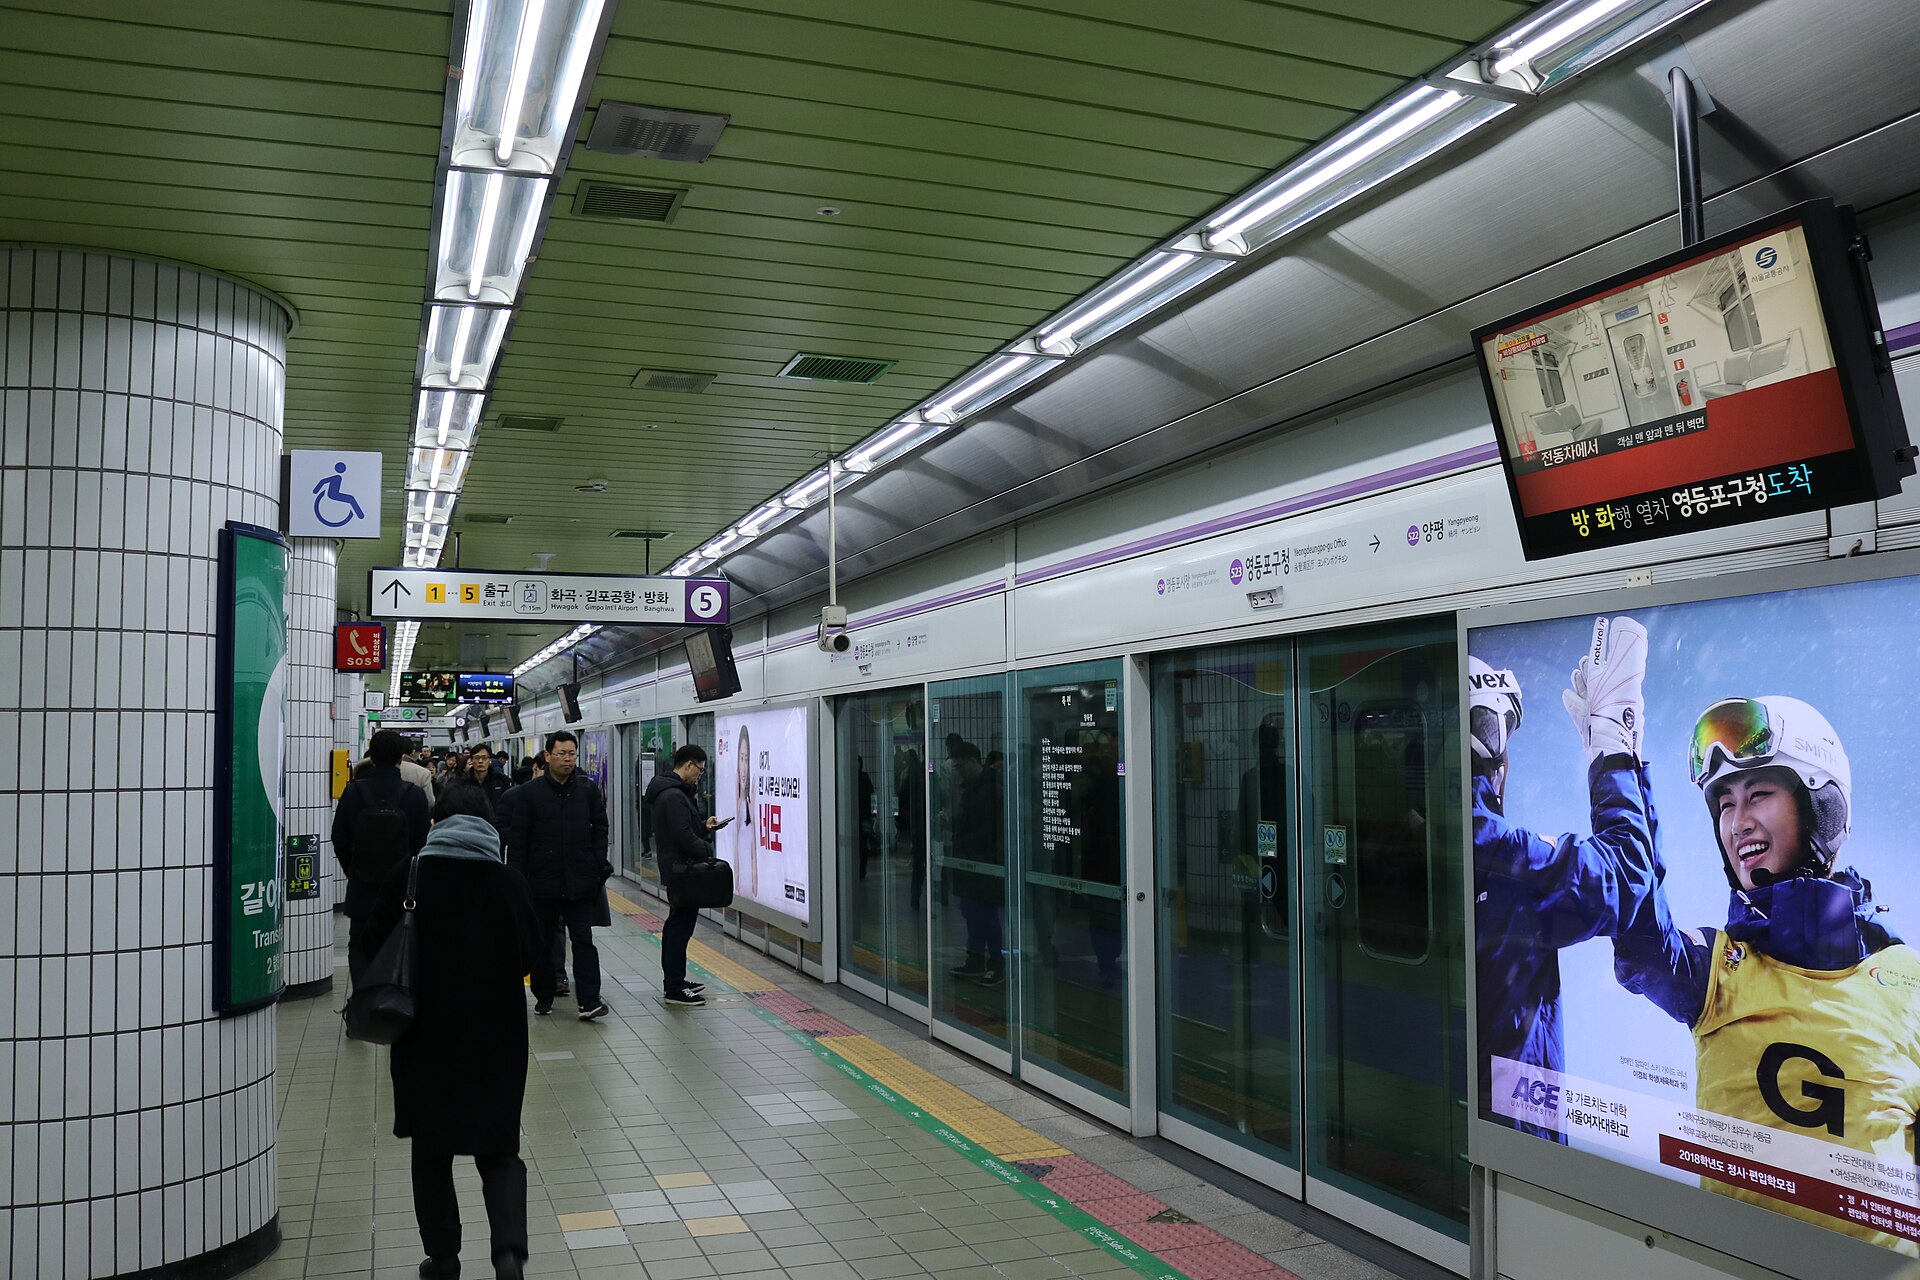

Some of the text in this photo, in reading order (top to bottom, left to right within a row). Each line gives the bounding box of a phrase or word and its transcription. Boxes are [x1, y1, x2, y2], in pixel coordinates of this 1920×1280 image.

[1635, 433, 1645, 443] 맨
[1645, 429, 1662, 442] 앞과
[1664, 426, 1674, 436] 맨
[1675, 422, 1685, 434] 뒤
[1687, 416, 1705, 429] 벽면
[1541, 438, 1599, 467] 전동차에서
[1447, 514, 1479, 527] Yangpyeong
[1637, 498, 1670, 526] 열차
[1407, 530, 1419, 541] 522
[1422, 518, 1444, 542] 양평
[1230, 566, 1242, 579] 523
[1245, 547, 1290, 582] 영등포구청
[431, 587, 474, 600] 1 5
[483, 583, 510, 598] 출구
[551, 588, 669, 605] 화곡 김포공항 방화
[483, 599, 496, 607] Exit
[551, 603, 579, 611] Hwagok
[585, 604, 604, 612] Gimpo
[617, 604, 638, 612] Airport
[644, 605, 675, 613] Banghwa
[700, 592, 712, 612] 5
[346, 657, 372, 666] SOS
[1469, 673, 1510, 690] vex
[1794, 737, 1837, 767] SMITH
[759, 803, 783, 853] 네모
[1511, 1076, 1560, 1111] ACE
[1757, 1042, 1845, 1138] G
[1510, 1101, 1558, 1119] UNIVERSITY
[1565, 1089, 1627, 1119] 잘 가르치는 대학
[1565, 1108, 1630, 1138] 서울여자대학교
[1732, 1124, 1752, 1139] 최우수
[1740, 1142, 1754, 1154] 대학
[1679, 1149, 1796, 1194] 2018학년도 정시·편입학모집
[1835, 1152, 1876, 1173] 수도권대학
[1877, 1163, 1904, 1180] 특성화
[1847, 1207, 1869, 1222] 편입학
[1870, 1214, 1893, 1230] 인터넷
[1870, 1202, 1892, 1216] 인터넷
